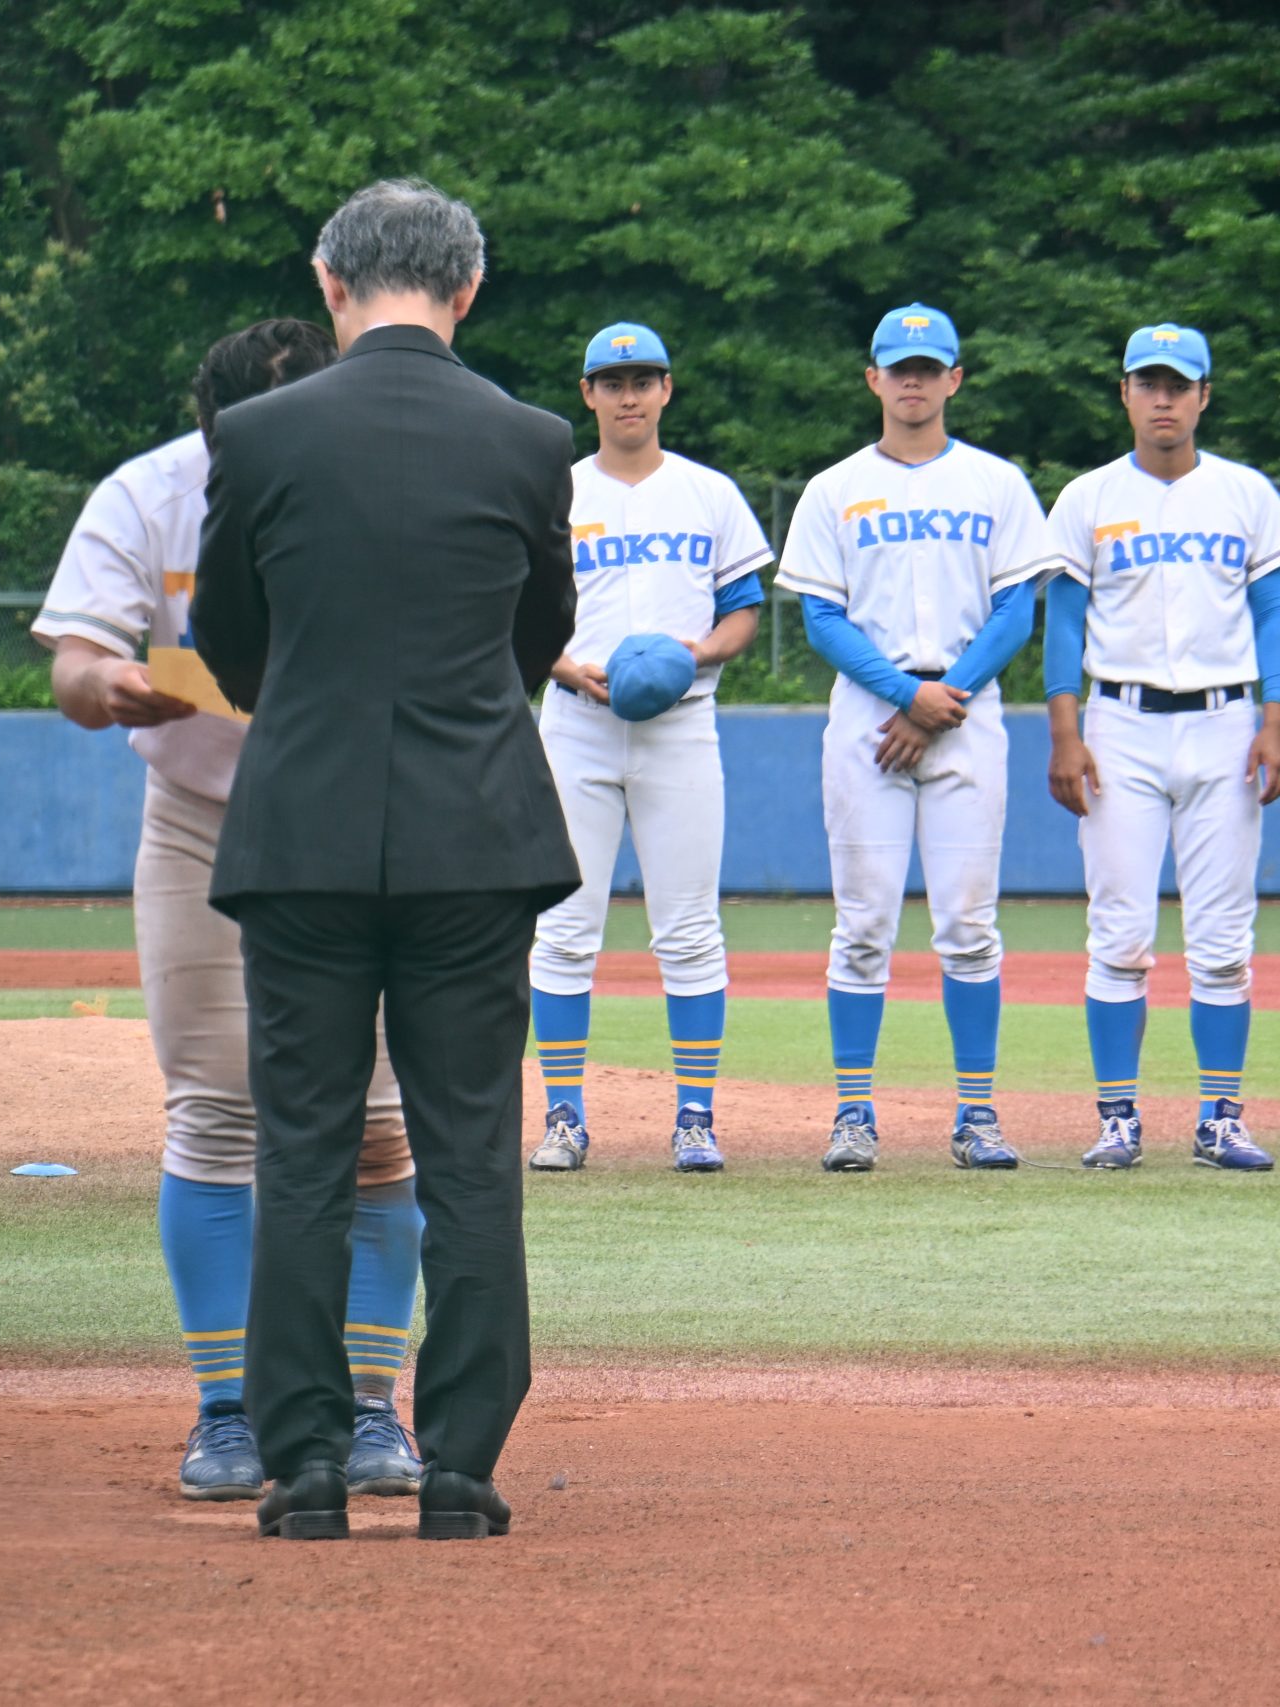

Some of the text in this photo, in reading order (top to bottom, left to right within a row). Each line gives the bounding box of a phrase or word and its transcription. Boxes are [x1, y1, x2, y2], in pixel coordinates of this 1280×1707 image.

[571, 522, 712, 572] TOKYO
[843, 498, 993, 548] TOKYO
[1094, 520, 1245, 572] TOKYO
